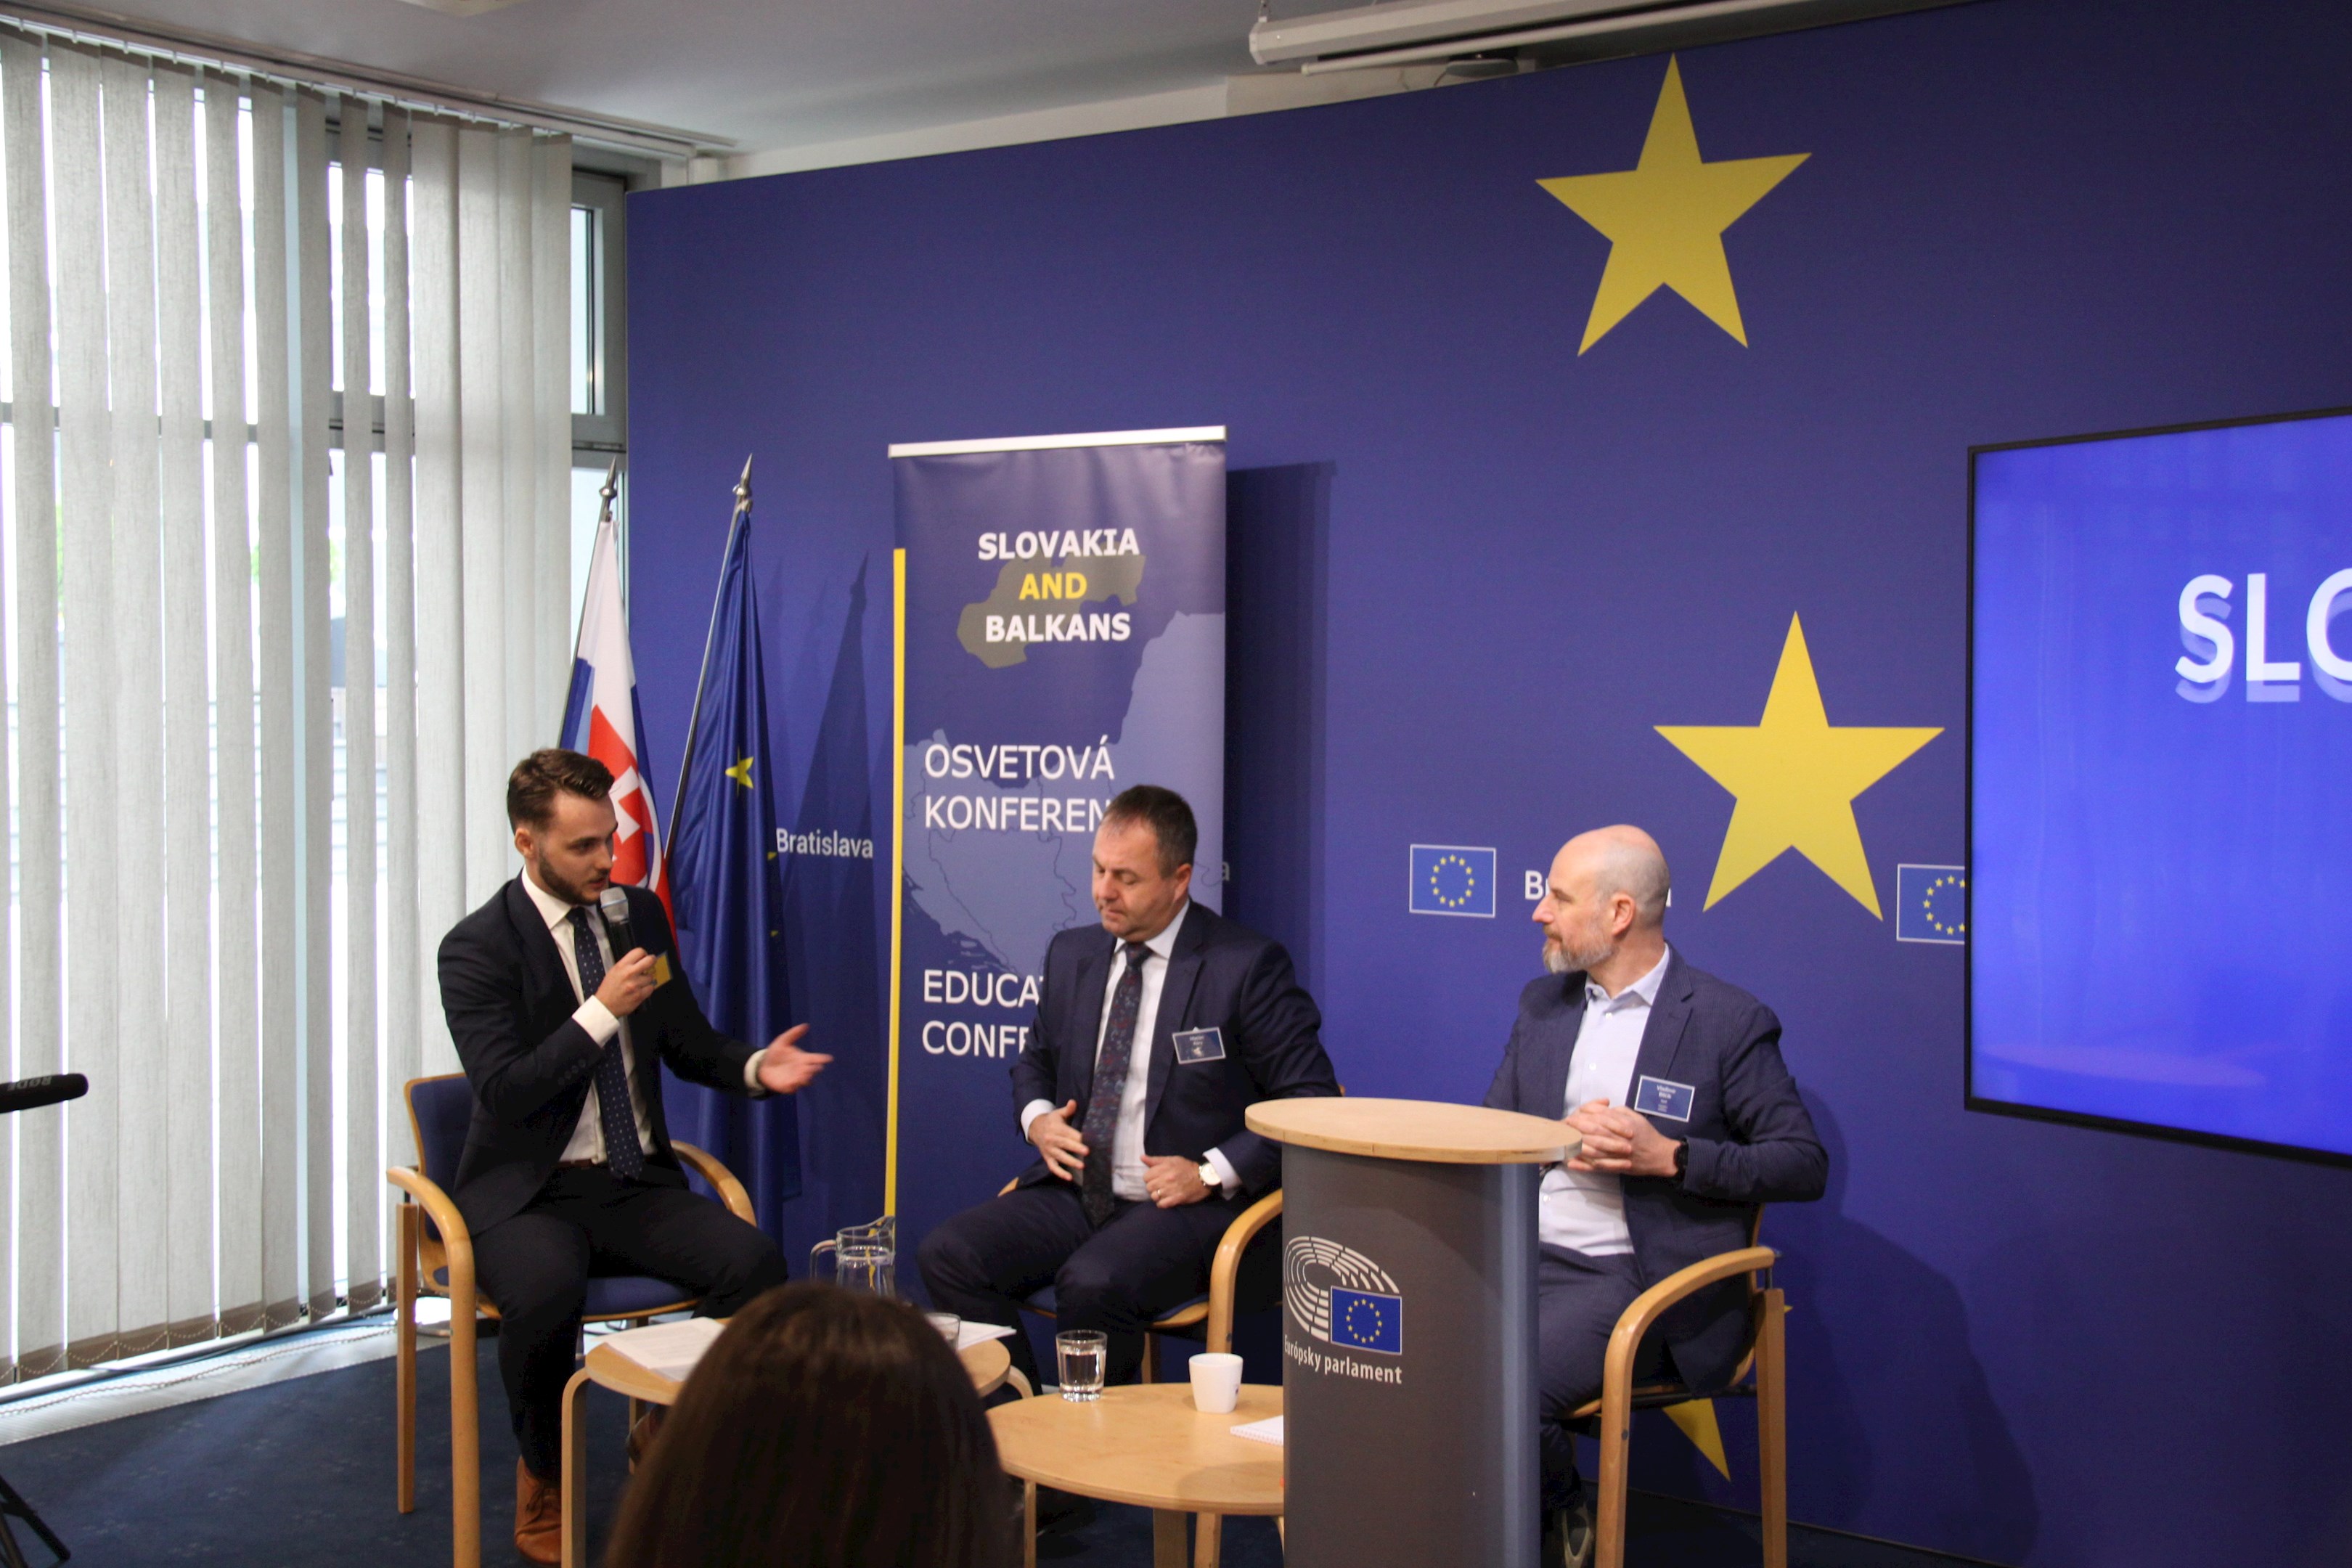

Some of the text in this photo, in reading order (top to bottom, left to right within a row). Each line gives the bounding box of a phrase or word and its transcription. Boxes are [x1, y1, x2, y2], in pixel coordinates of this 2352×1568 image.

[978, 528, 1140, 560] SLOVAKIA
[1018, 572, 1087, 600] AND
[985, 612, 1131, 642] BALKANS
[924, 734, 1115, 780] OSVETOVÁ
[776, 828, 873, 859] Bratislava
[923, 968, 1044, 1008] EDUCA
[1284, 1334, 1402, 1385] Európsky parlament
